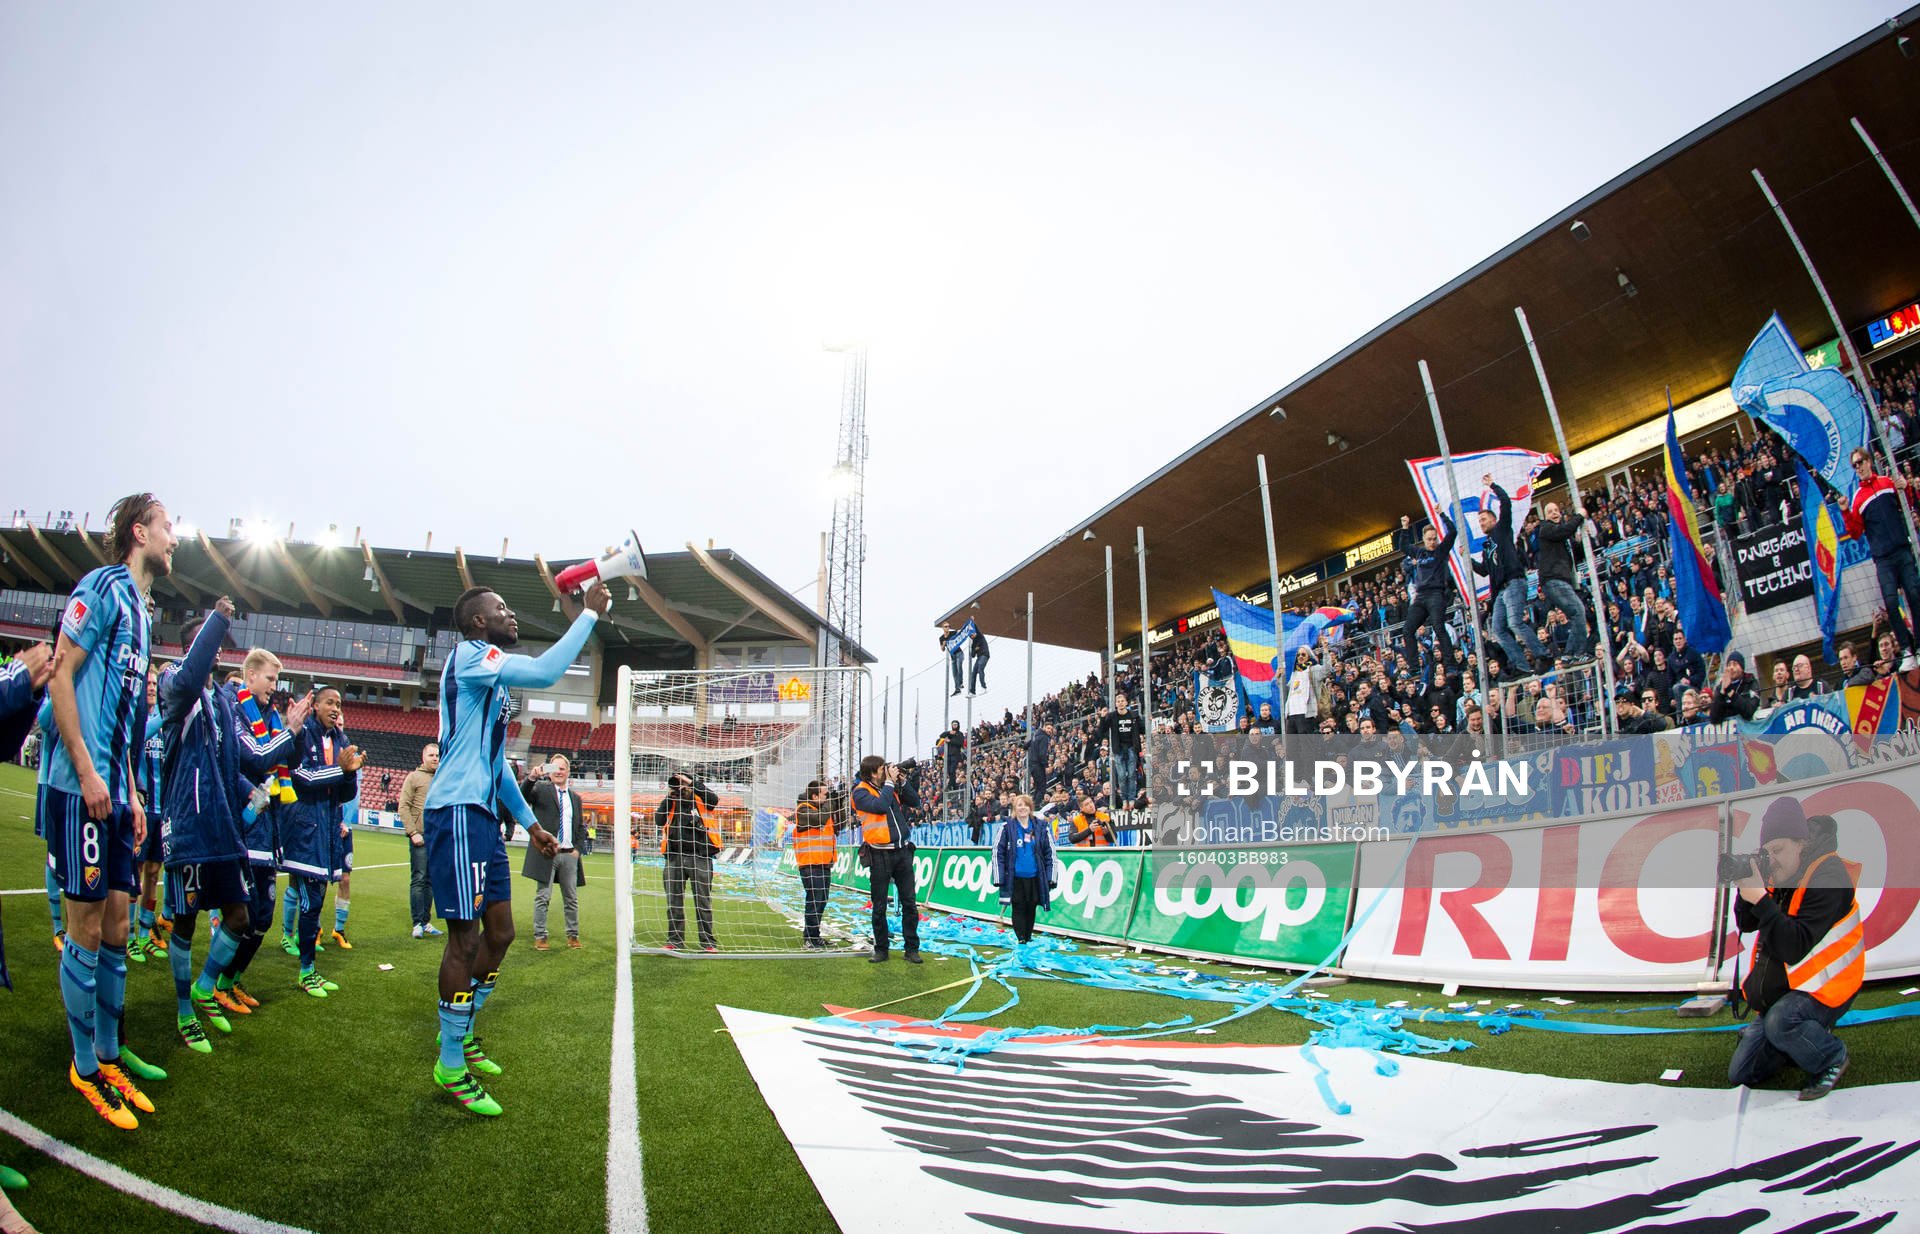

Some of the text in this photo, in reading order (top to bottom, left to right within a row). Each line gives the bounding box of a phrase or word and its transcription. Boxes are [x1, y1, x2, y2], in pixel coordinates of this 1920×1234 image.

[1745, 560, 1814, 598] TECHNO
[778, 676, 811, 701] MAX
[1695, 719, 1738, 748] LOVE
[1784, 709, 1806, 731] ÄR
[83, 822, 99, 864] 8
[1154, 860, 1327, 942] coop
